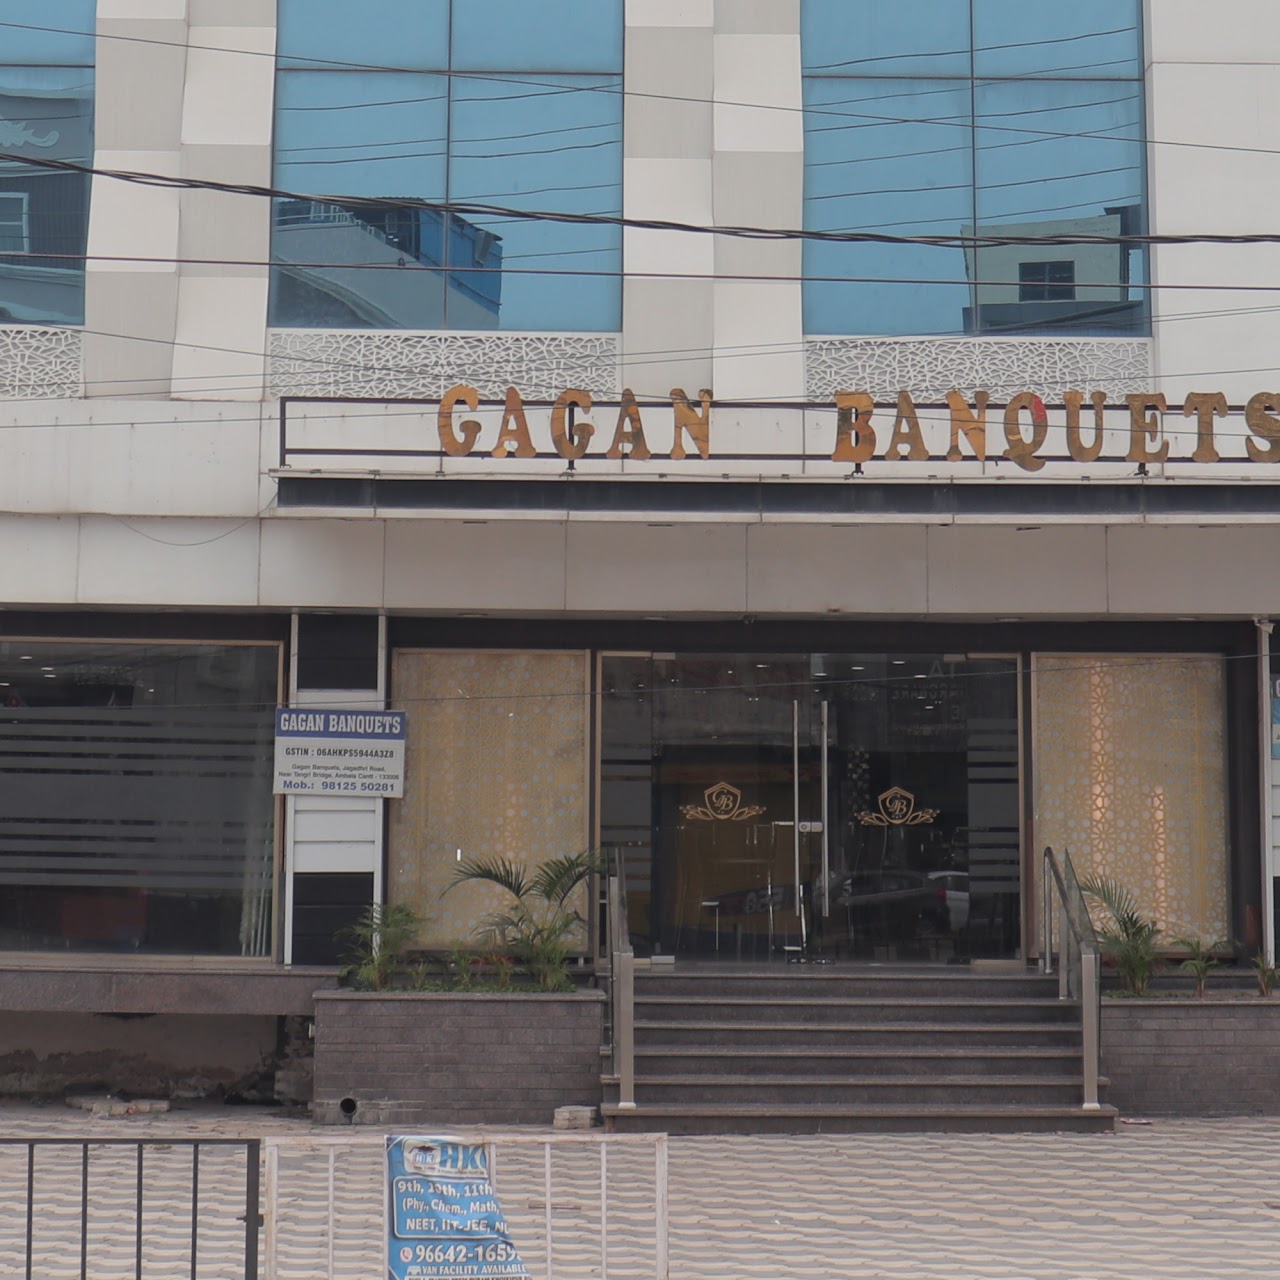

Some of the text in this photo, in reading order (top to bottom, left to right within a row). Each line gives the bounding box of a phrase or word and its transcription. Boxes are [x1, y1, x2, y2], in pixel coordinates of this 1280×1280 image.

[438, 384, 713, 460] GAGAN
[280, 713, 401, 734] GAGAN BANQUETS
[285, 747, 309, 756] GSTIN
[321, 781, 357, 791] 98125
[360, 782, 395, 792] 50281
[398, 1180, 493, 1199] 9th, 10th, 11th
[470, 1200, 500, 1215] Math,
[406, 1218, 438, 1234] NEET,
[415, 1244, 521, 1263] 96642-1659
[422, 1263, 527, 1275] VAN FACILITY AVAILABLE
